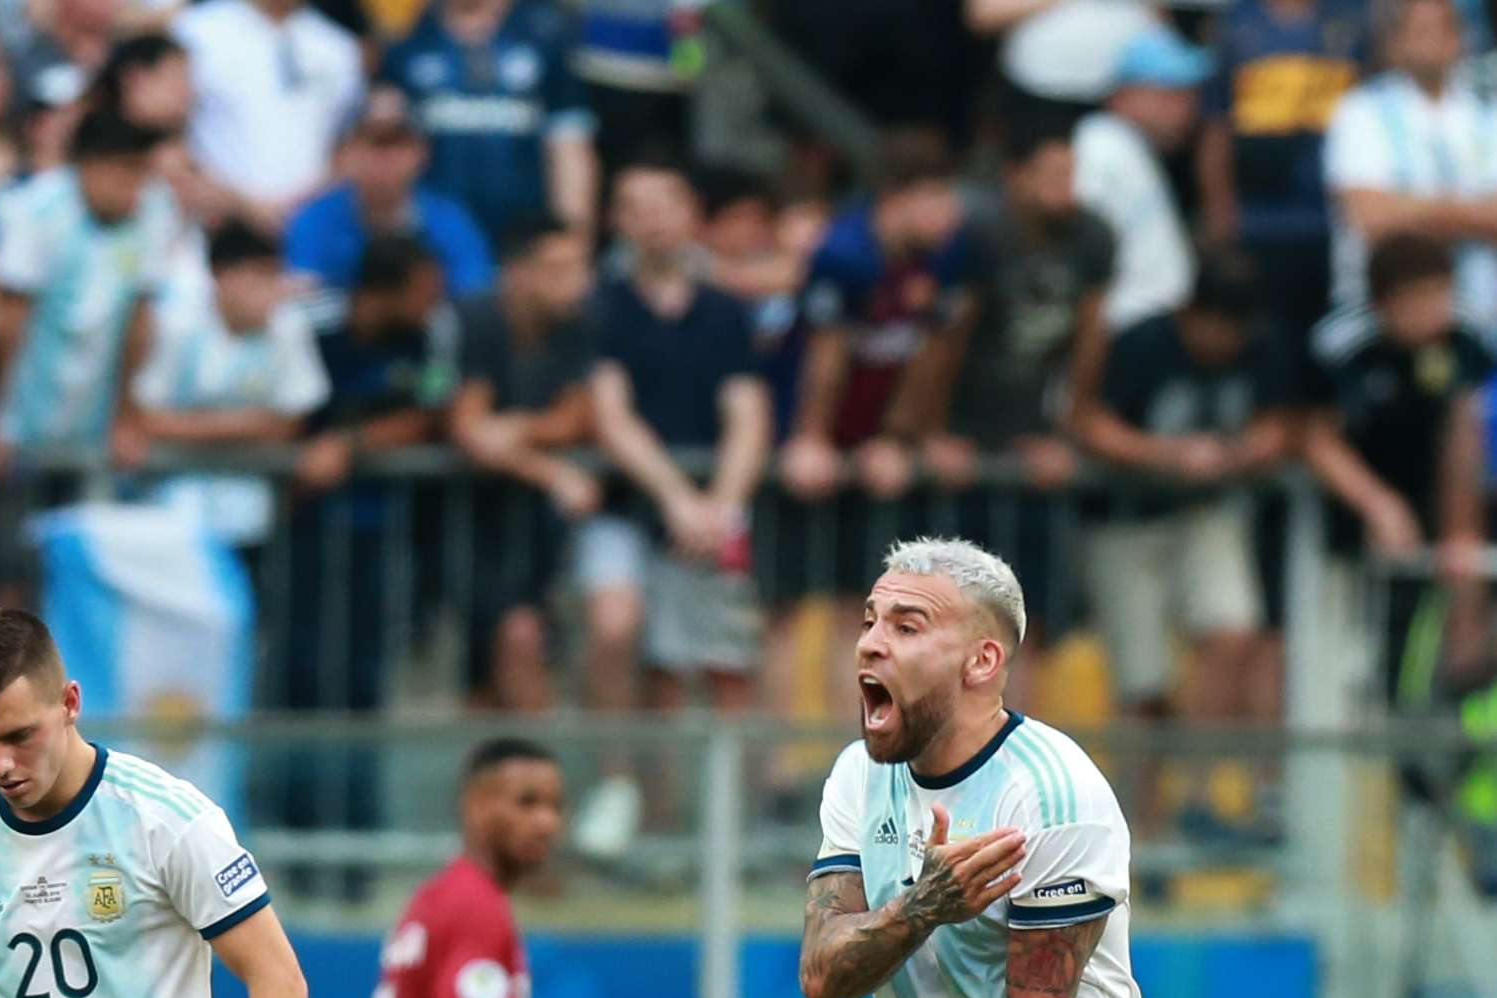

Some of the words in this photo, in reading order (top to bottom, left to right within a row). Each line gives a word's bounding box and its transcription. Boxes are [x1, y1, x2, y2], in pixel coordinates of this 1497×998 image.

[217, 866, 238, 885] Cree
[94, 885, 117, 909] AFA
[1037, 888, 1064, 899] Cree
[1067, 883, 1083, 895] en
